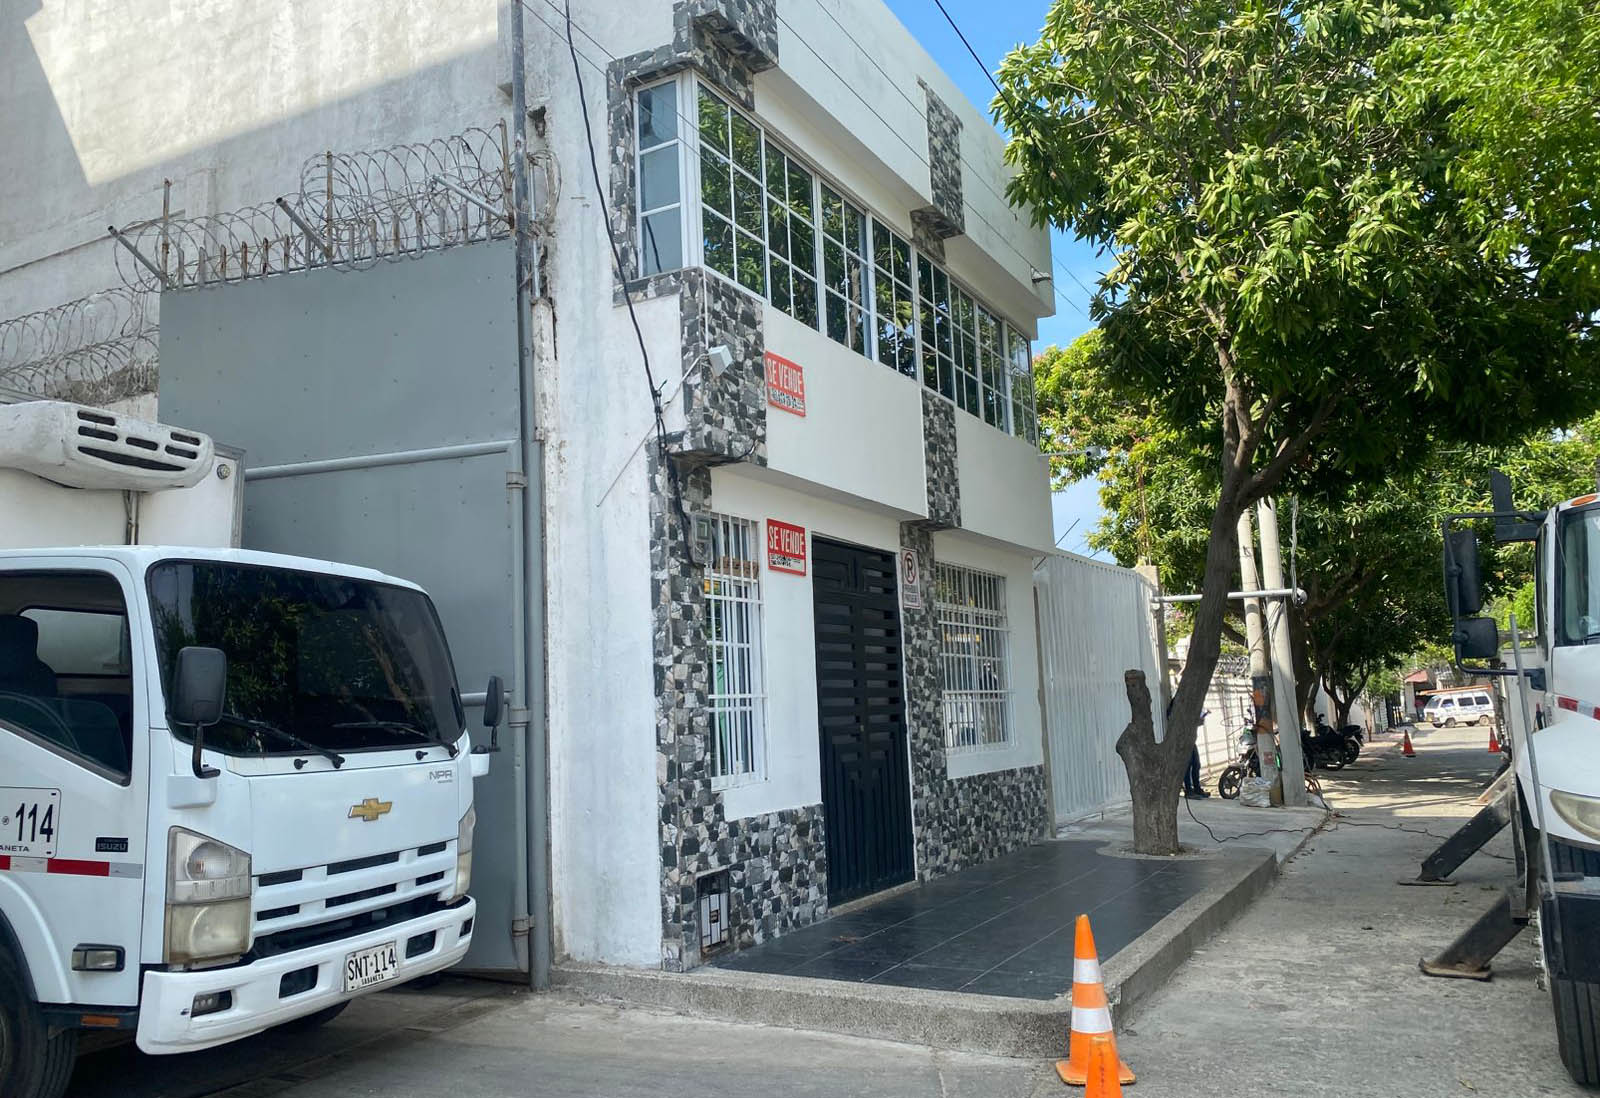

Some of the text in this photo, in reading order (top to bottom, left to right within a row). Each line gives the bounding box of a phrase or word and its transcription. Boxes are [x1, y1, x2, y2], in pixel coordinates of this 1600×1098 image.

[767, 357, 804, 396] SE VENDE
[768, 525, 805, 556] SE VENDE
[429, 769, 453, 780] NPR
[15, 802, 54, 843] 114
[97, 842, 127, 851] ISUZU
